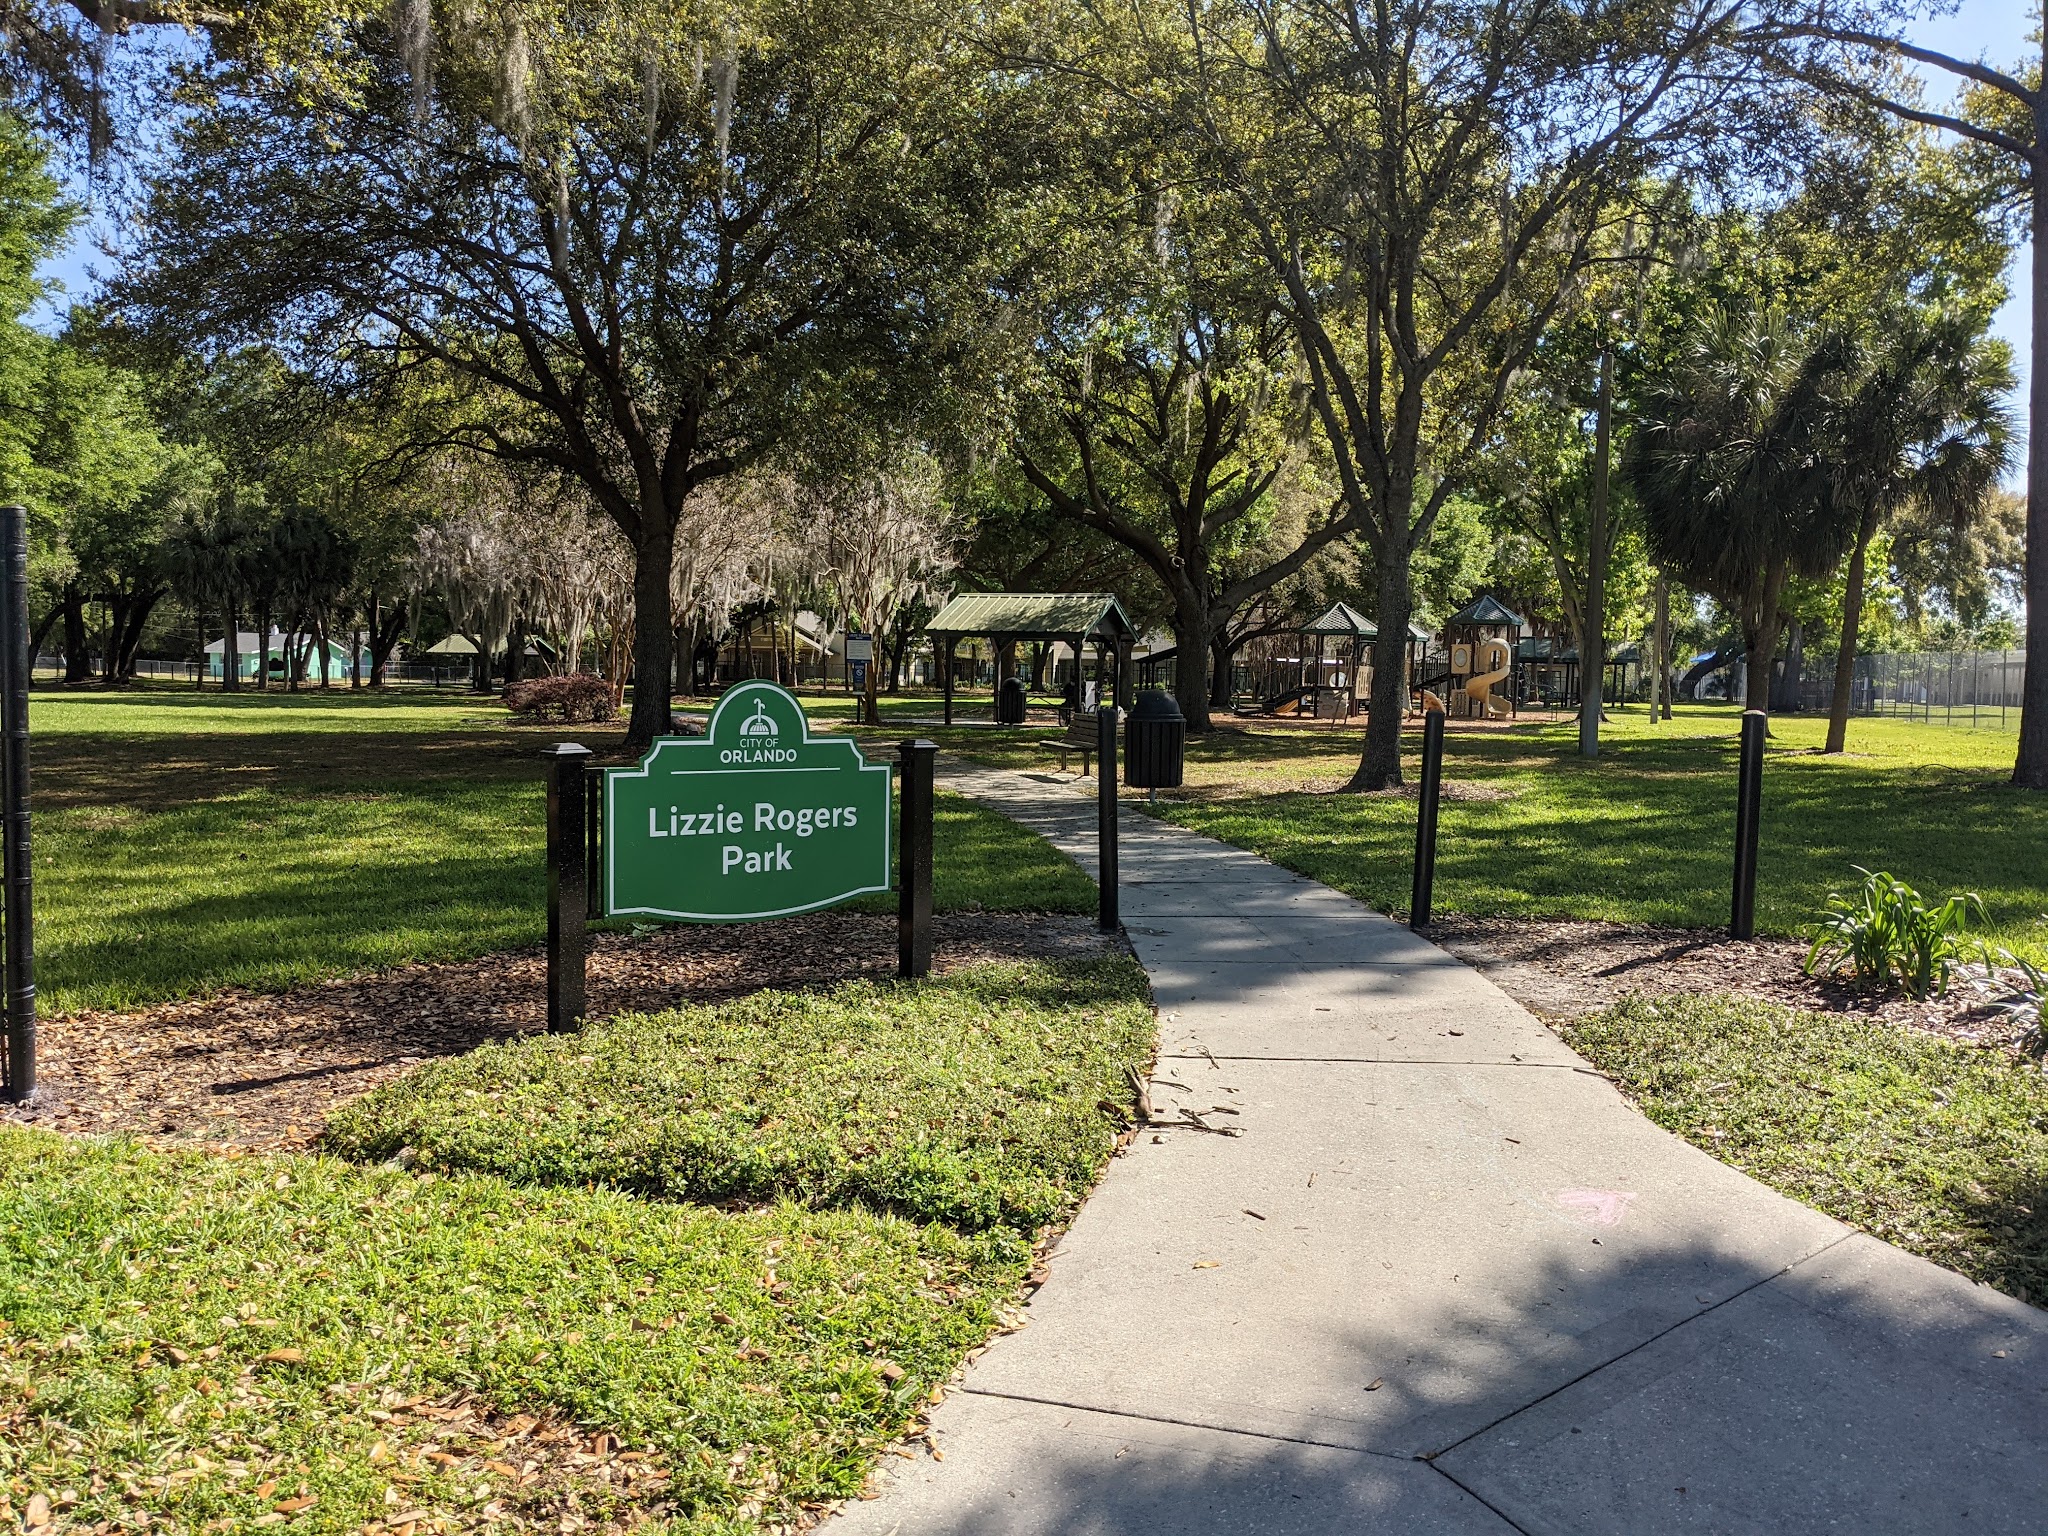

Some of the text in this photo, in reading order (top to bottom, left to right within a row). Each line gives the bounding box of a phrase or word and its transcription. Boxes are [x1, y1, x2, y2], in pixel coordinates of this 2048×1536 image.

[739, 738, 779, 748] CITY OF
[720, 749, 797, 763] ORLANDO
[649, 803, 858, 837] Lizzie Rogers
[723, 843, 792, 874] Park
